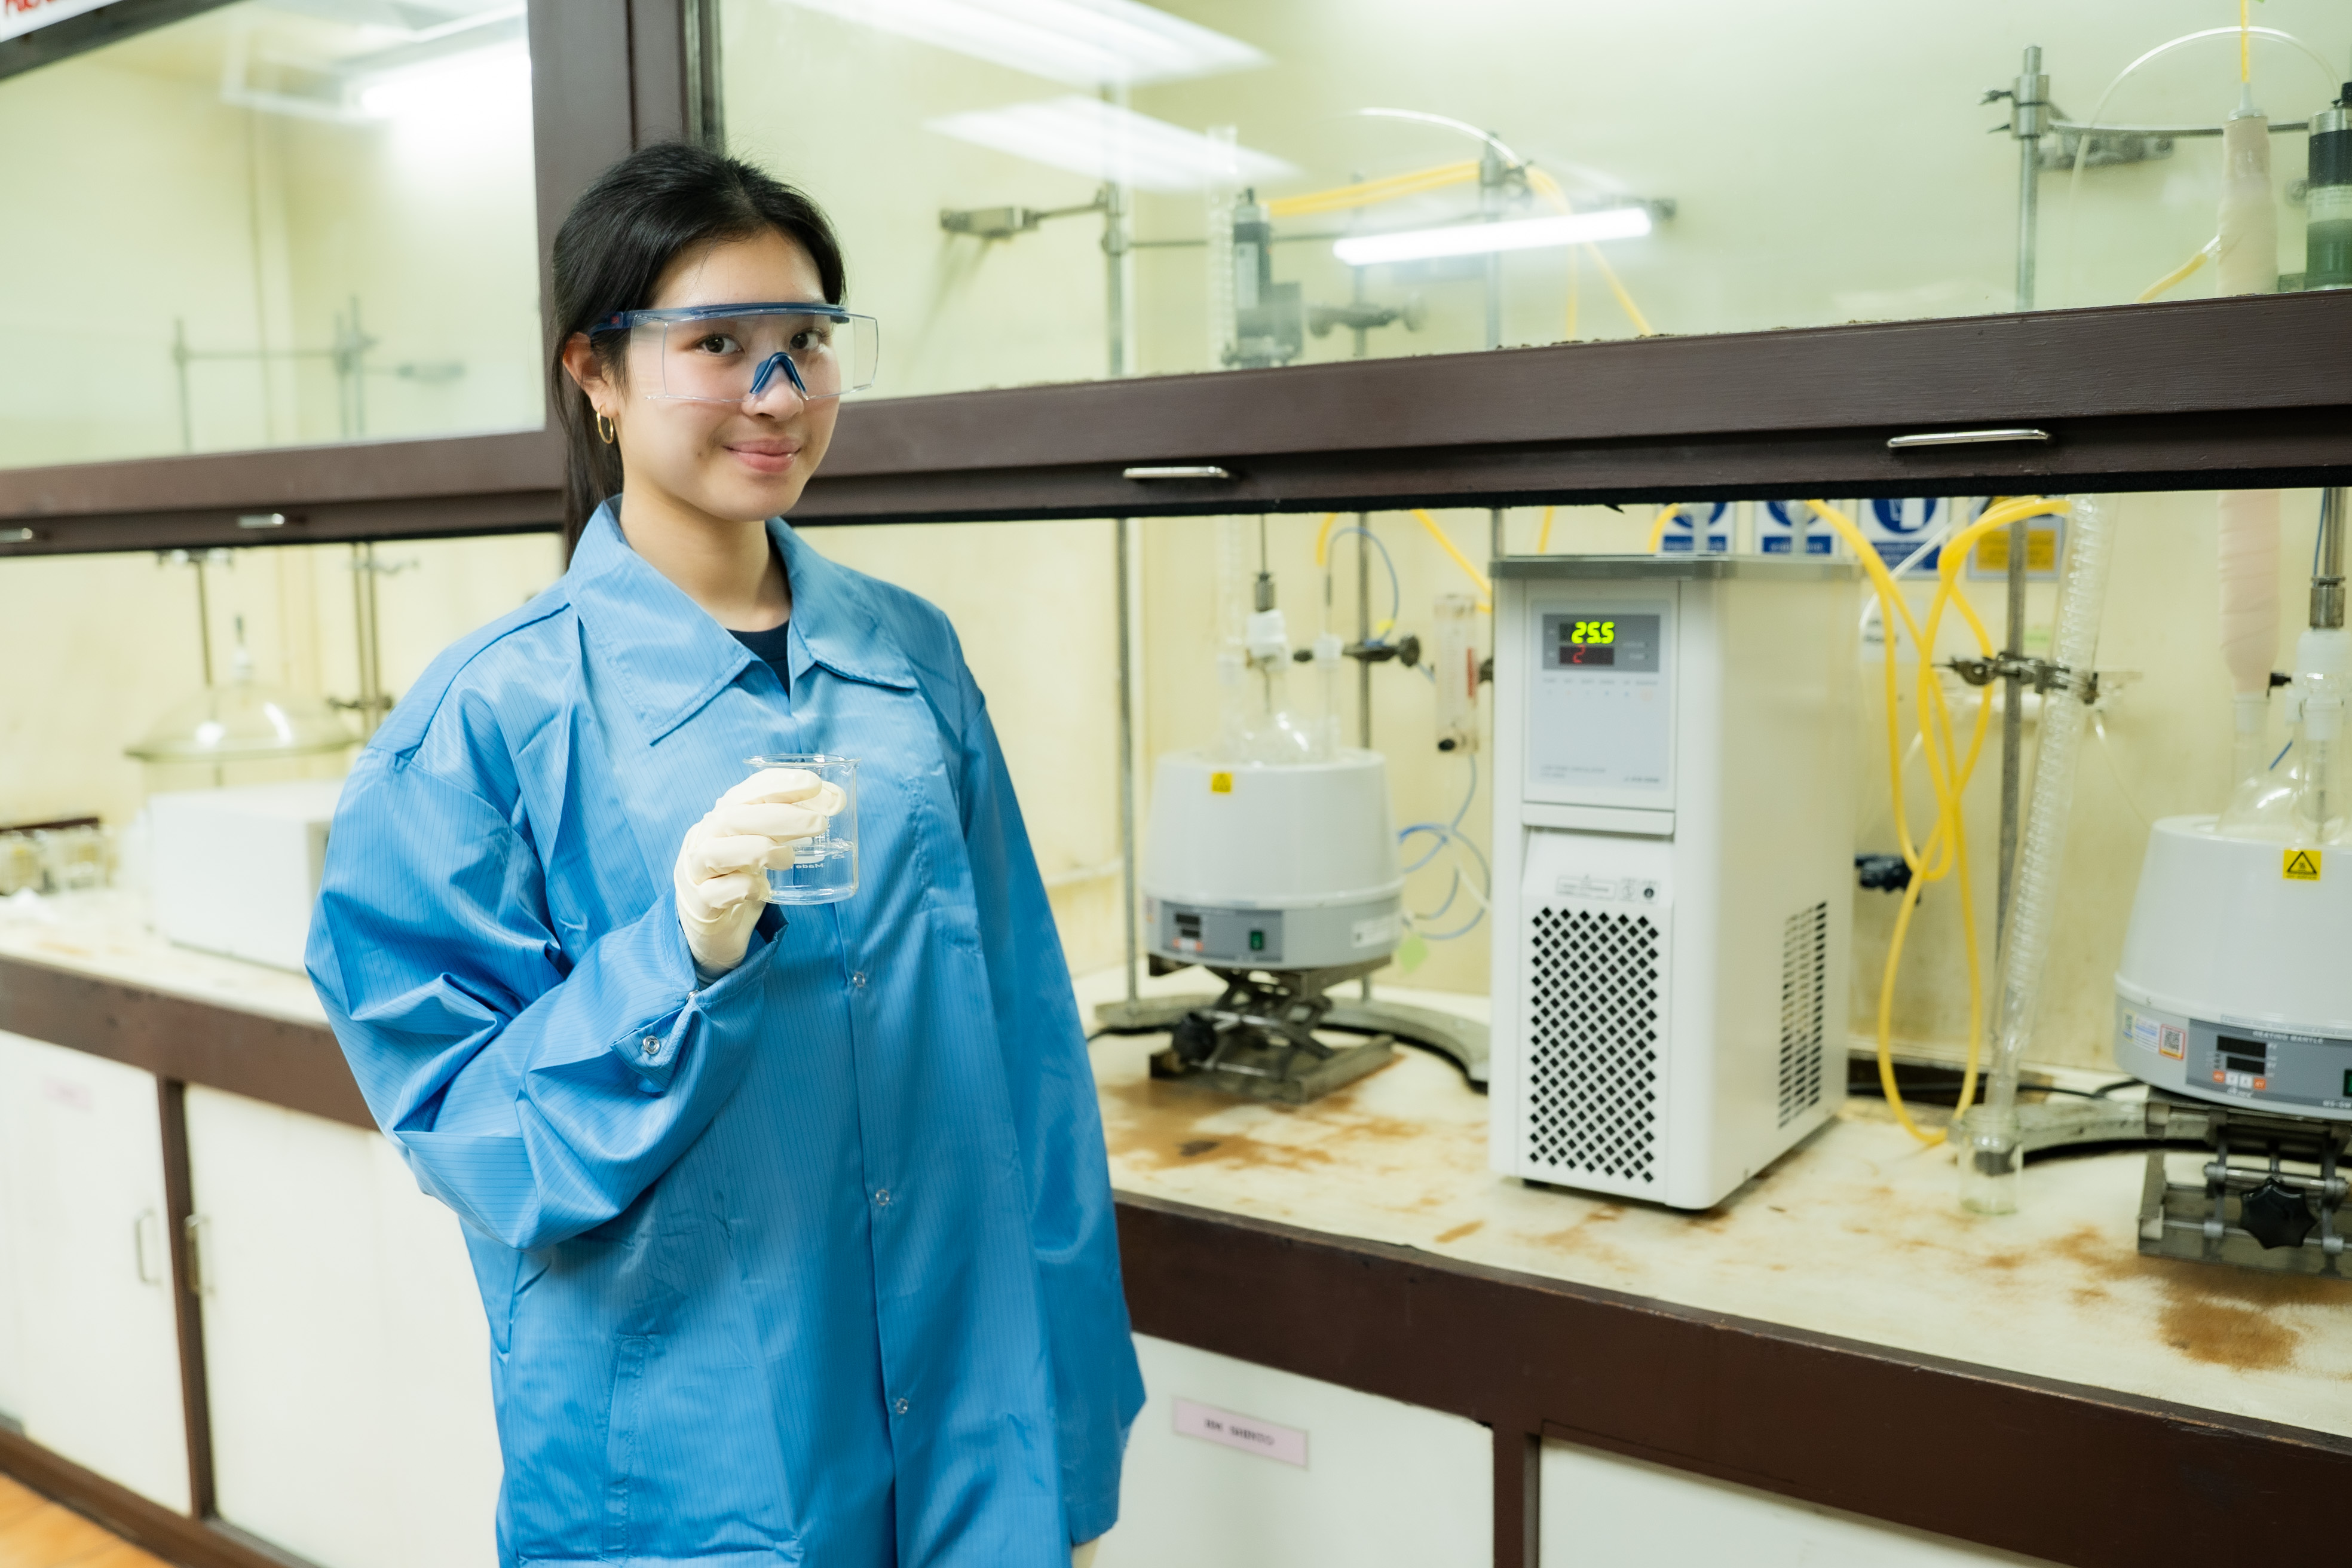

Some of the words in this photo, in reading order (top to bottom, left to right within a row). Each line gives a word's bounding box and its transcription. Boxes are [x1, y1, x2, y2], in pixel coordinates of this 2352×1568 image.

[1571, 621, 1615, 644] 25.5
[1572, 644, 1586, 663] 2
[2252, 1030, 2288, 1042] HEATING
[2290, 1035, 2324, 1045] MANTLE
